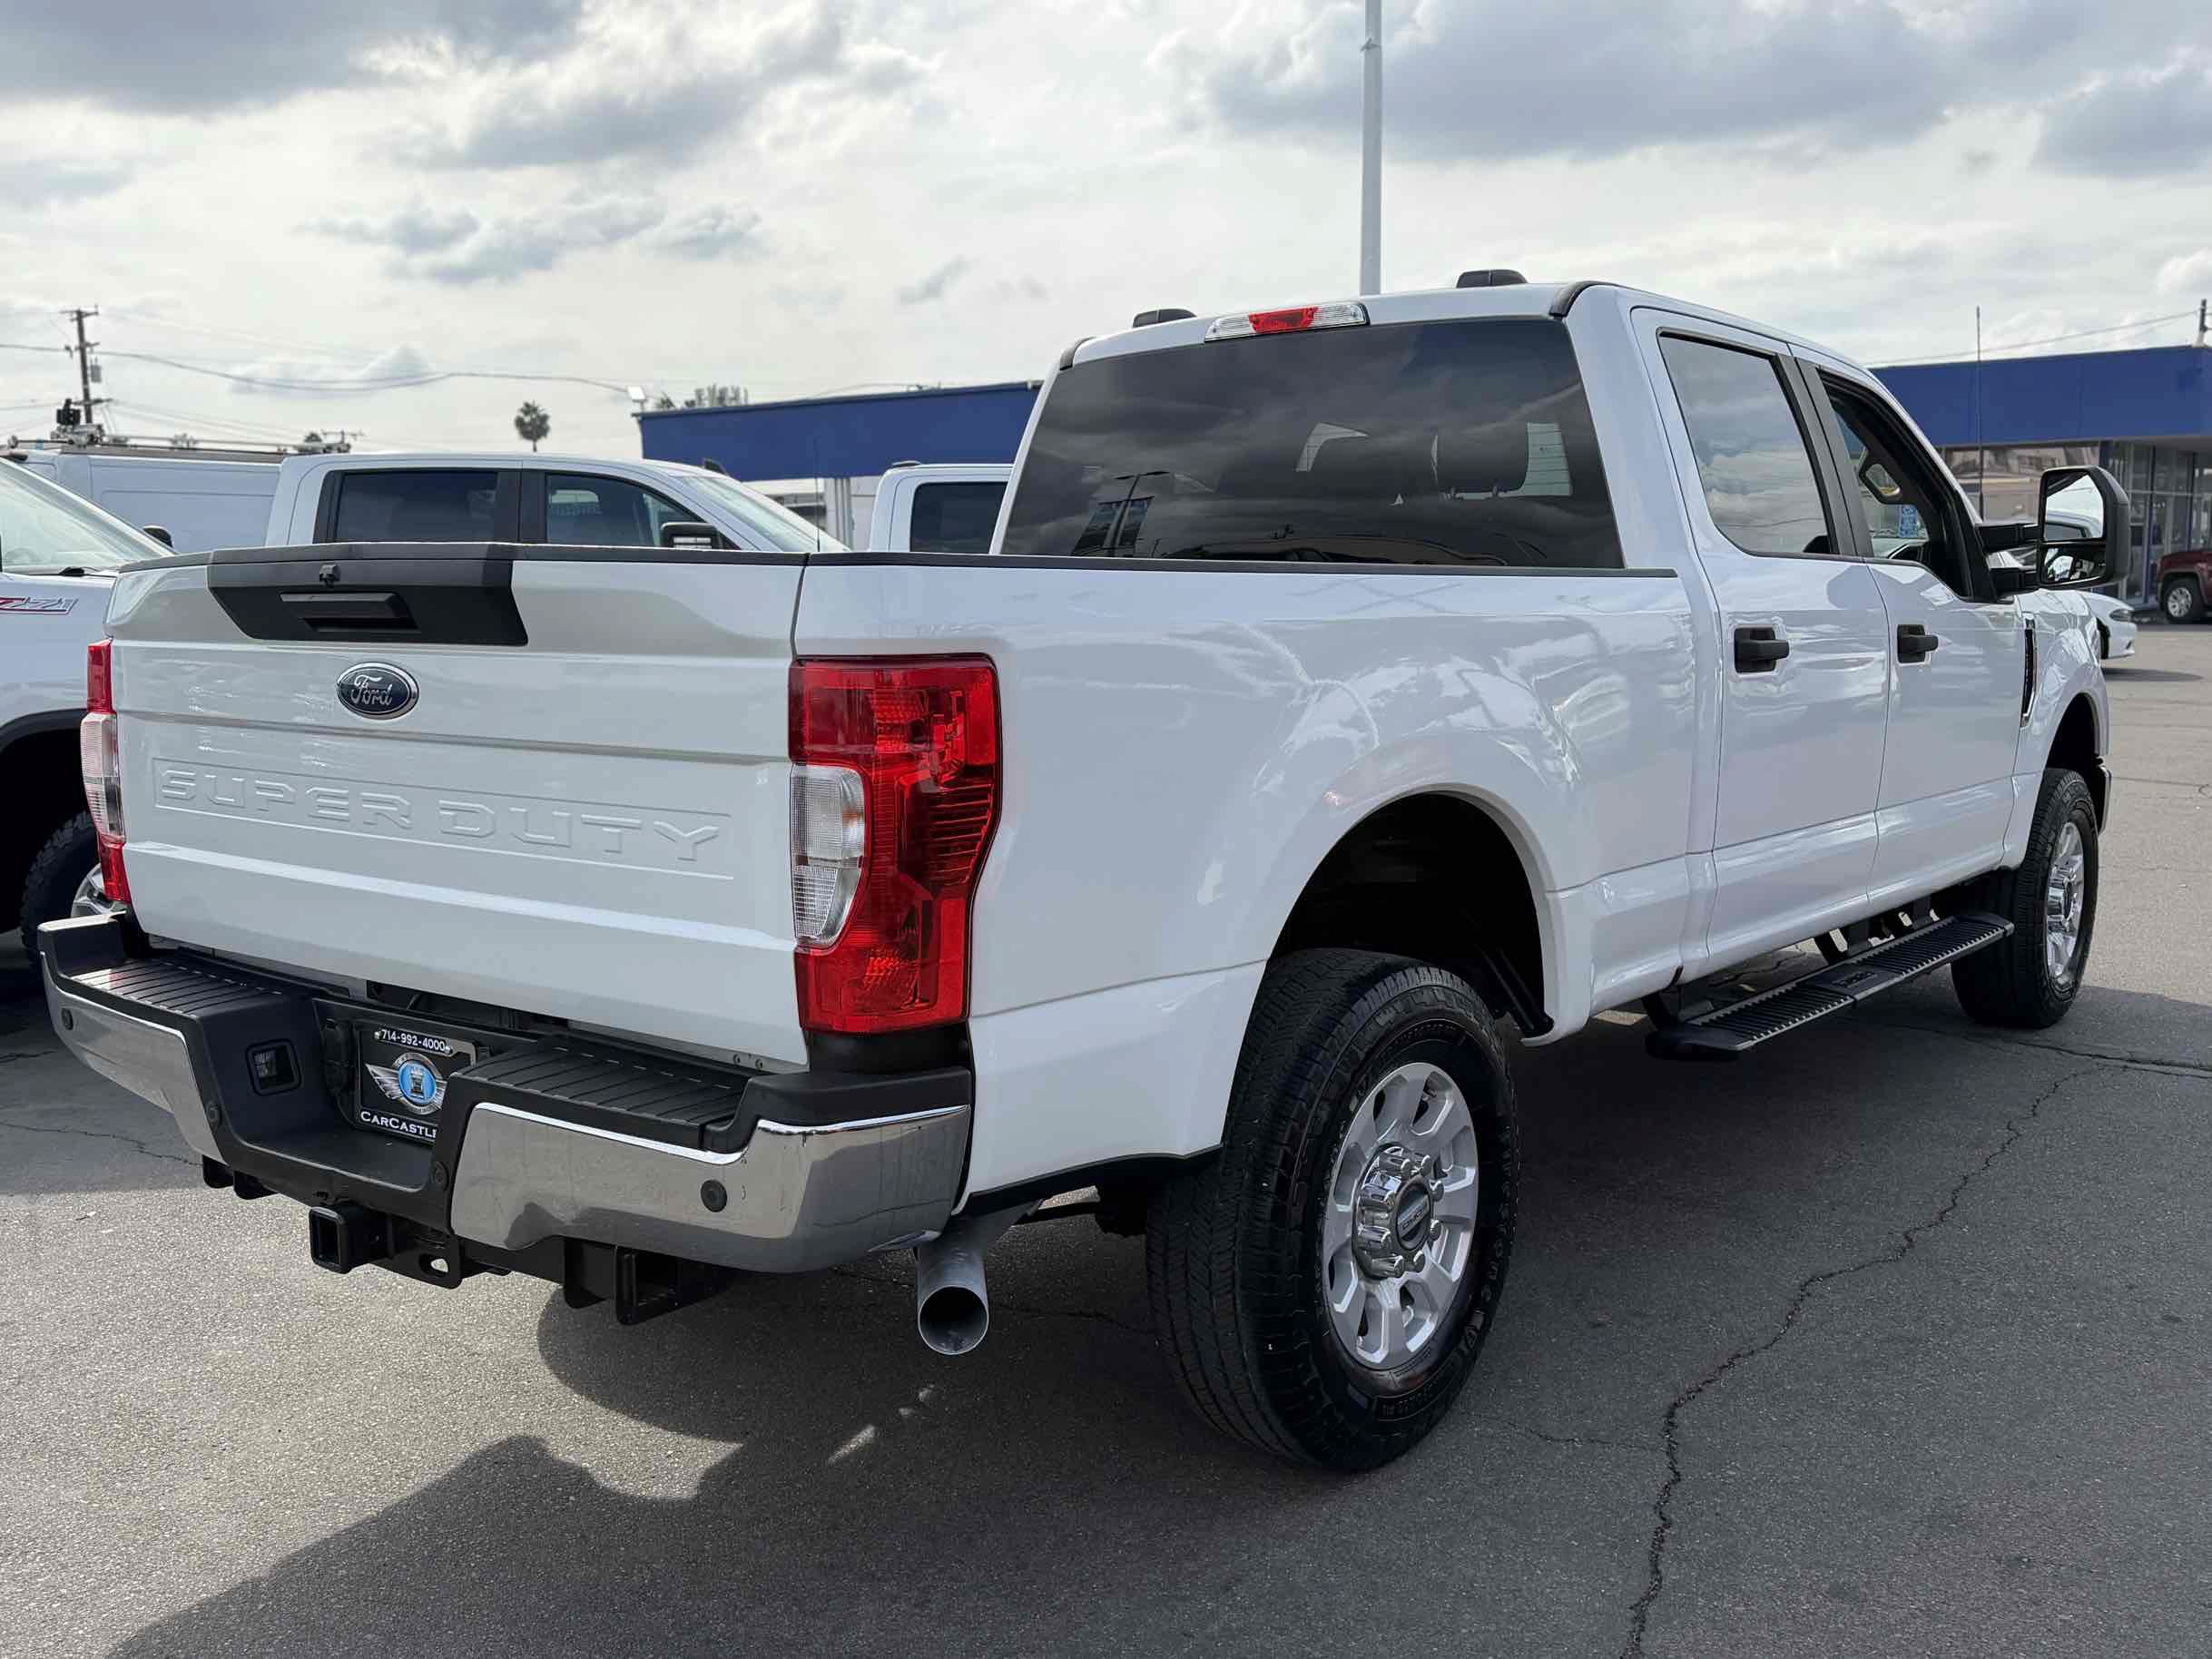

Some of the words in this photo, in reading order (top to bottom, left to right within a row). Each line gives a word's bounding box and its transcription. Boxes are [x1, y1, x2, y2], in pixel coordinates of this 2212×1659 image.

[350, 674, 394, 705] Ford
[161, 770, 413, 830] SUPER
[437, 799, 720, 862] DUTY
[380, 1028, 446, 1053] 714-992-4000
